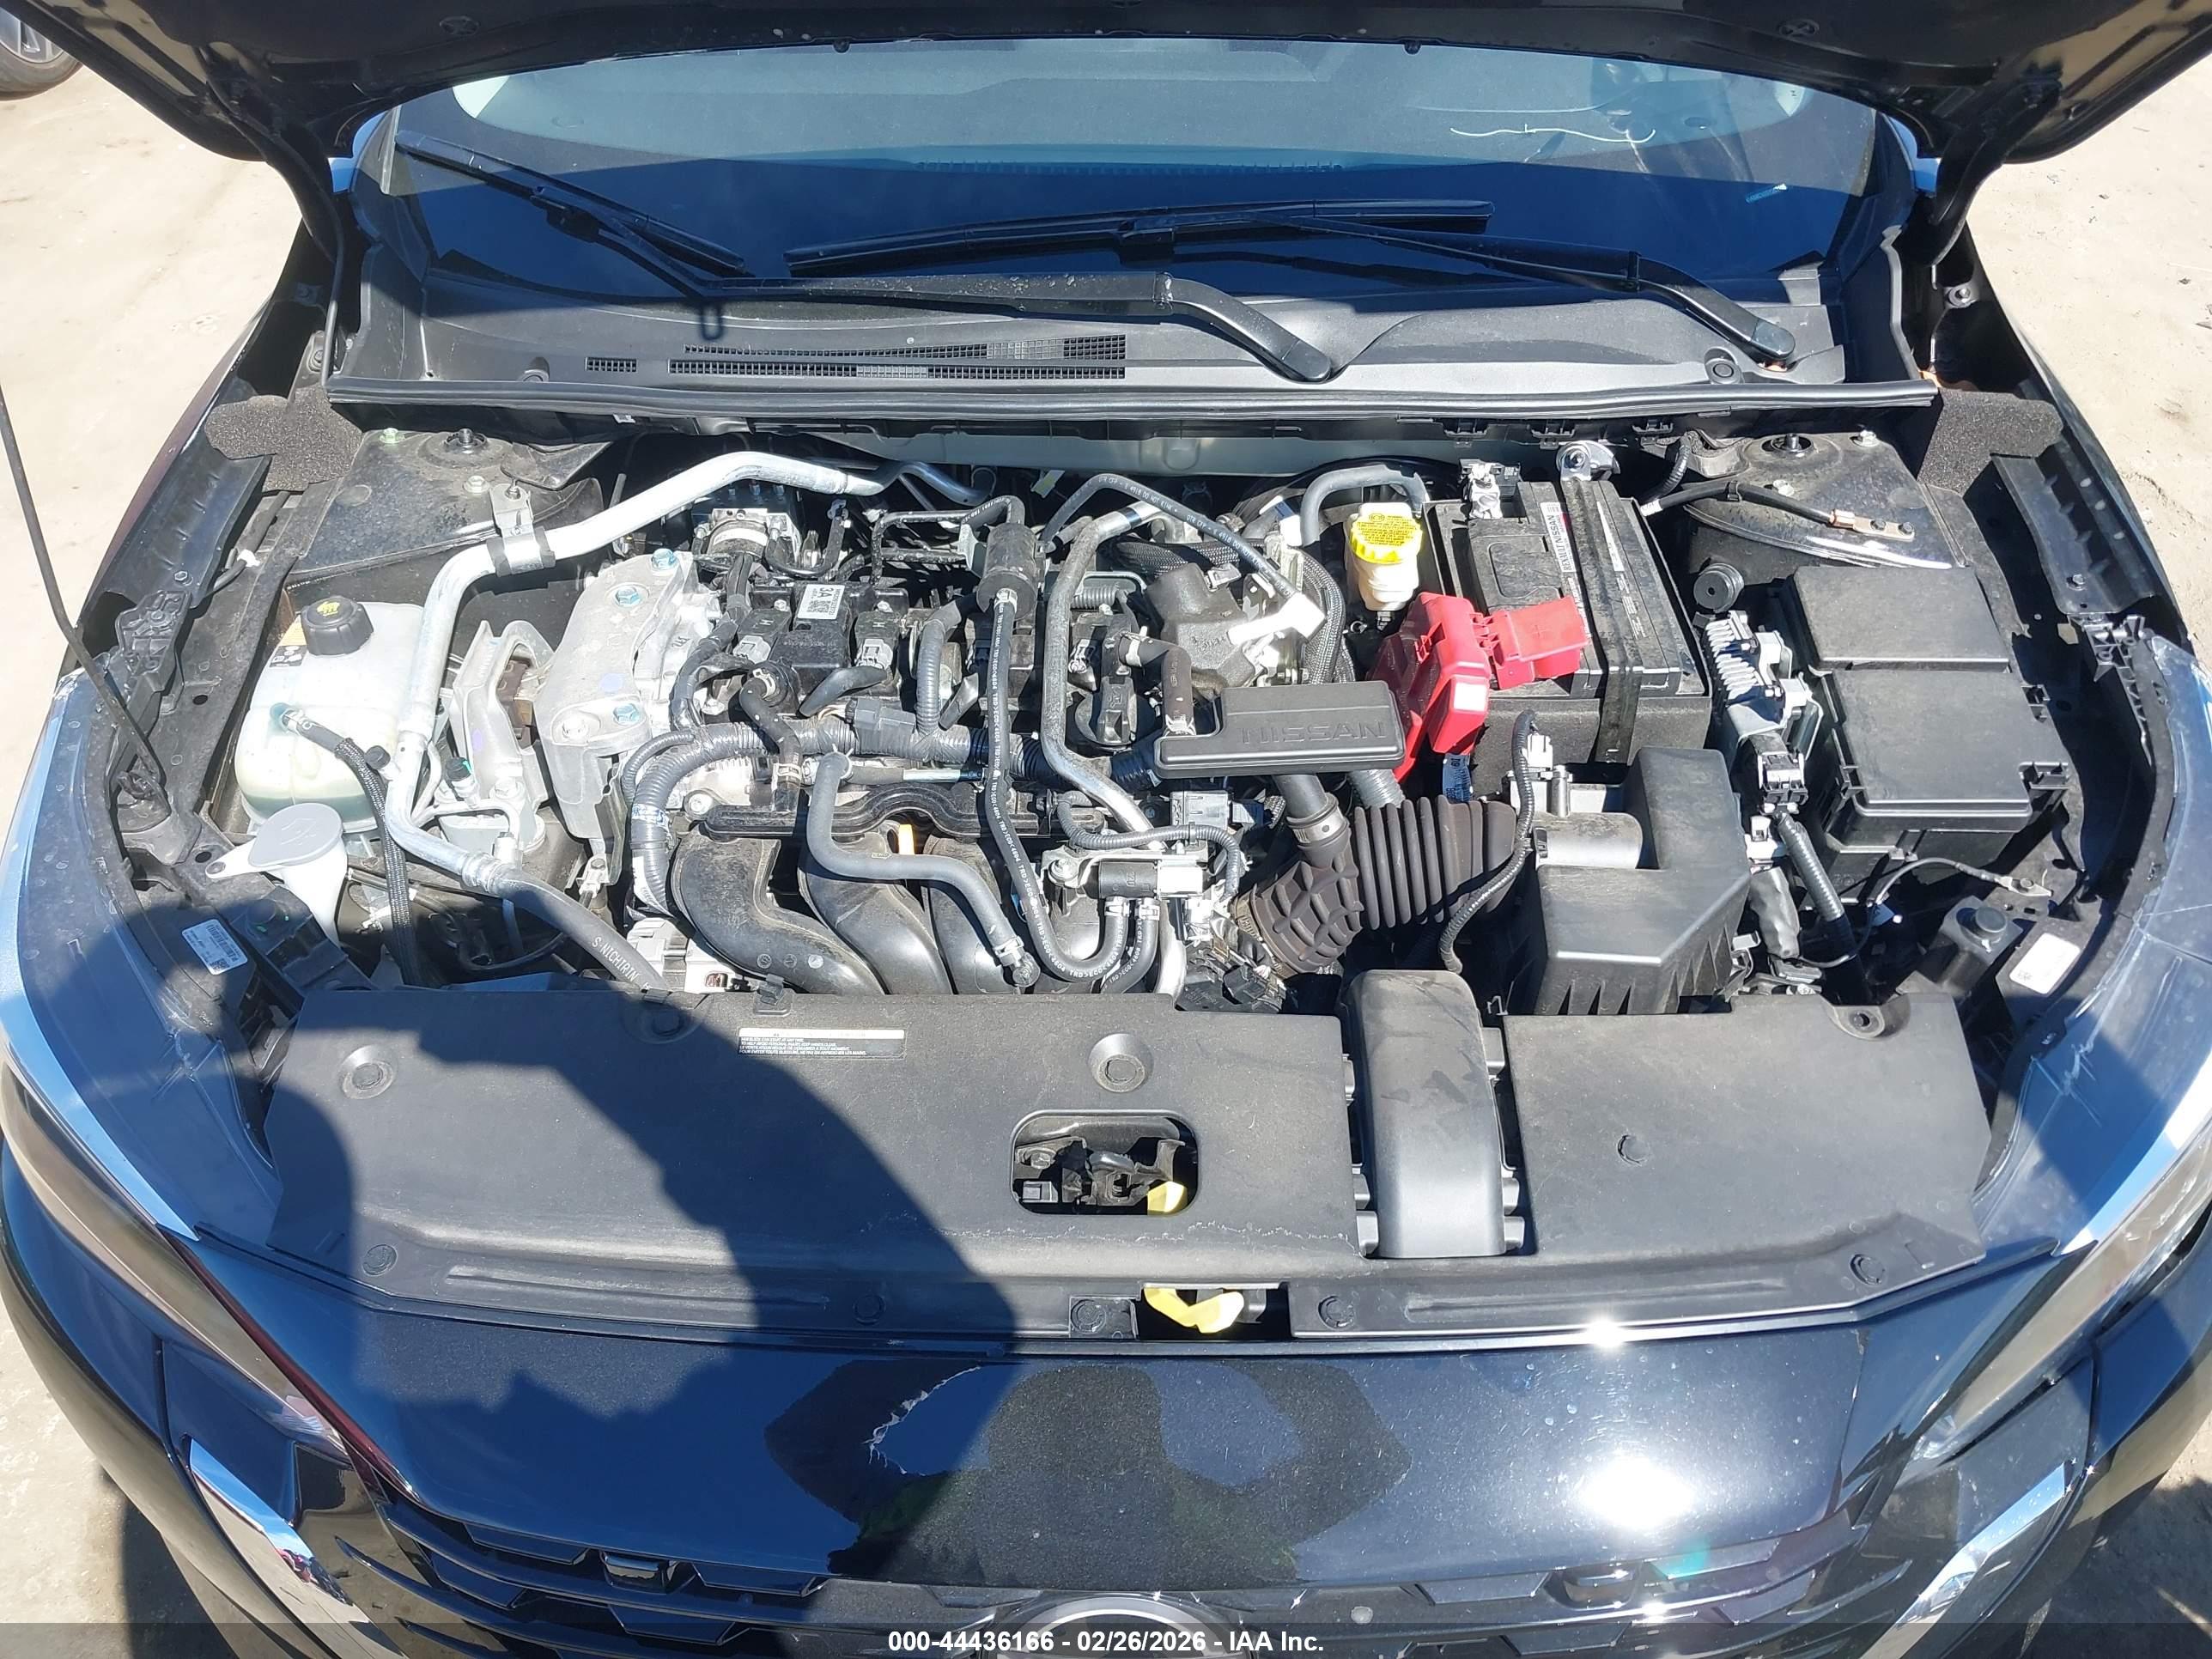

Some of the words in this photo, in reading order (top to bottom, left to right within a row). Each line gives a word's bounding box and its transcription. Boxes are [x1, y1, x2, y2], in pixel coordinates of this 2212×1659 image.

[1547, 514, 1562, 544] NISSAN
[1556, 544, 1572, 571] RENAULT
[817, 587, 834, 598] 3A
[1242, 722, 1387, 744] NISSAN
